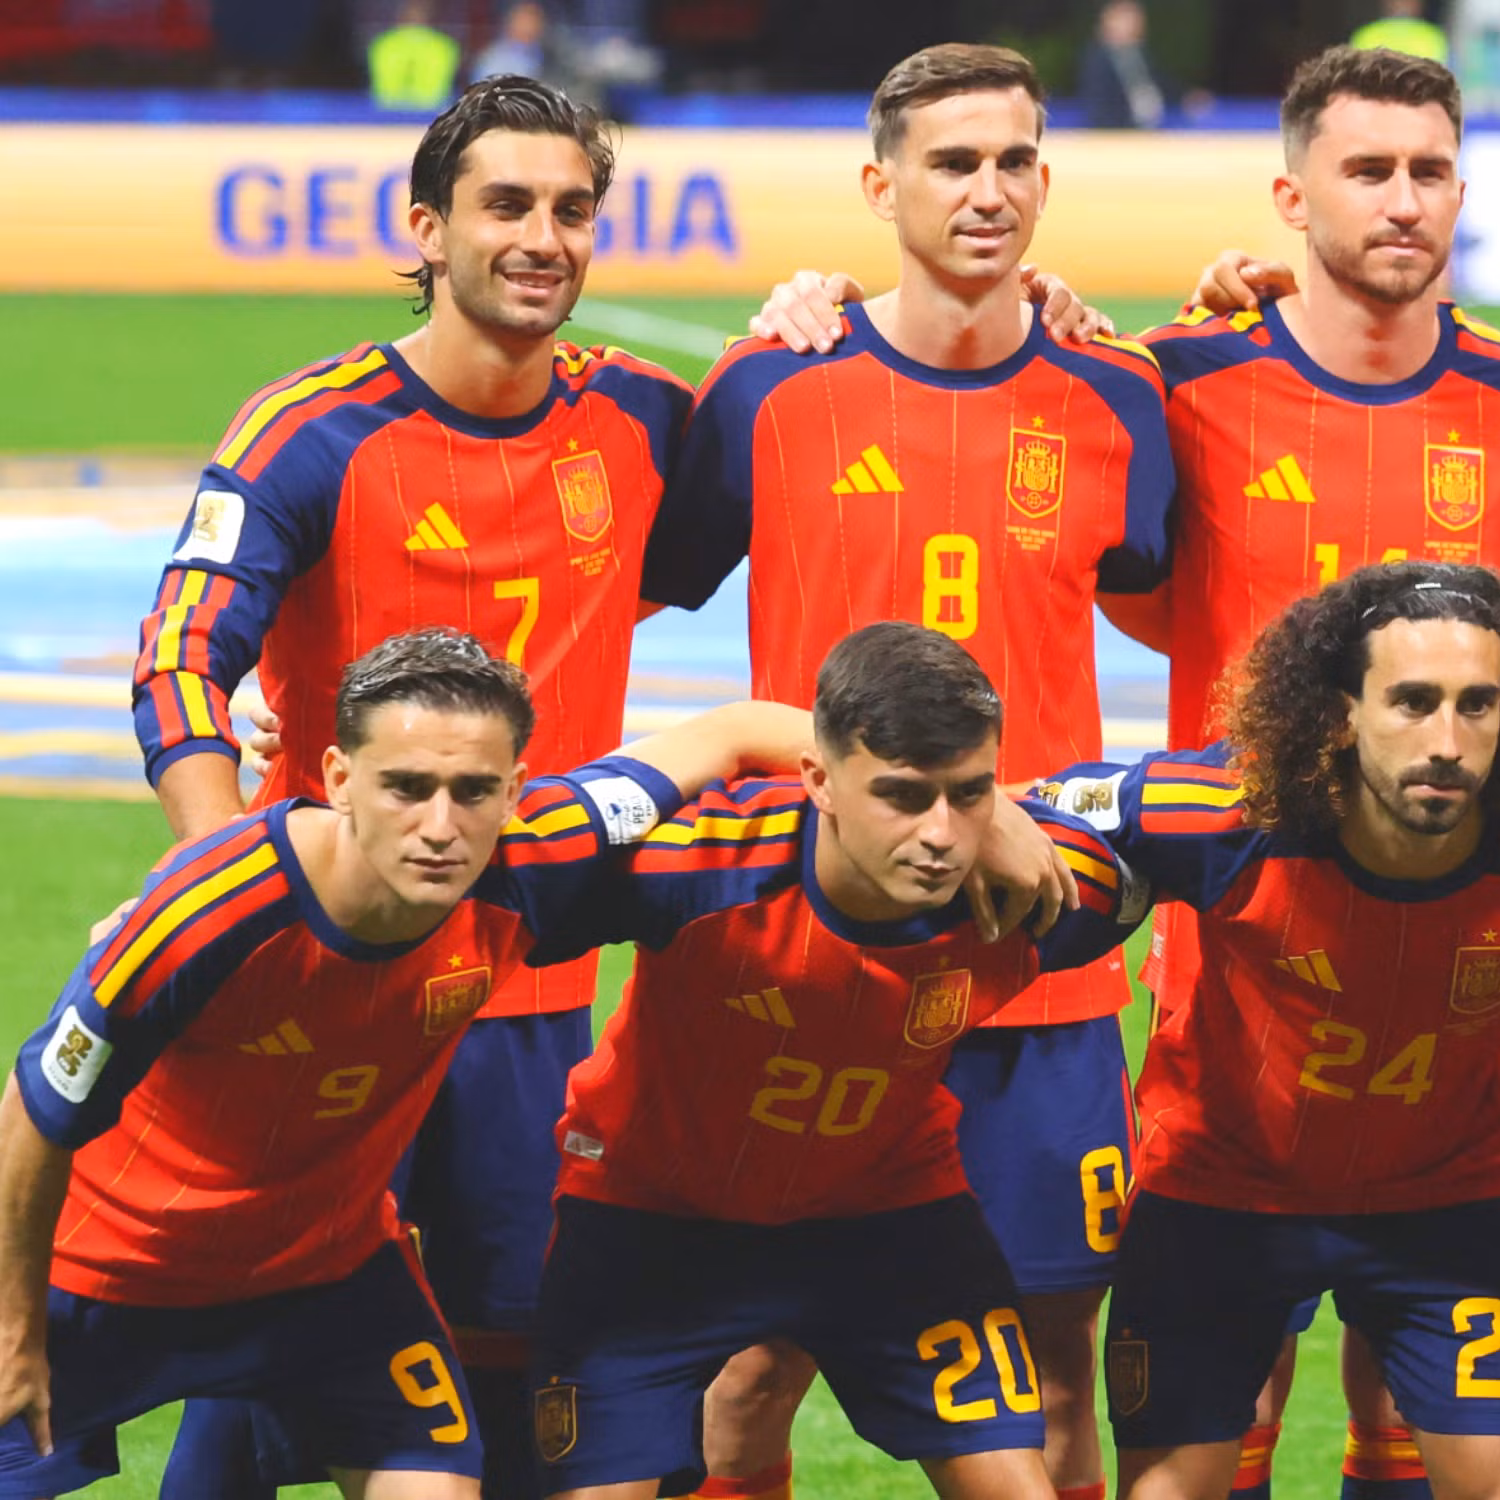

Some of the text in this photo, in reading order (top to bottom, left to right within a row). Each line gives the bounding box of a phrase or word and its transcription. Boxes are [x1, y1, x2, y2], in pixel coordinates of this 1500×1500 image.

[215, 163, 741, 258] GEOIA
[493, 577, 540, 667] 7
[923, 534, 978, 640] 8
[314, 1065, 380, 1120] 9
[750, 1055, 889, 1136] 20
[1299, 1020, 1437, 1105] 24
[389, 1340, 469, 1444] 9
[916, 1307, 1041, 1423] 20
